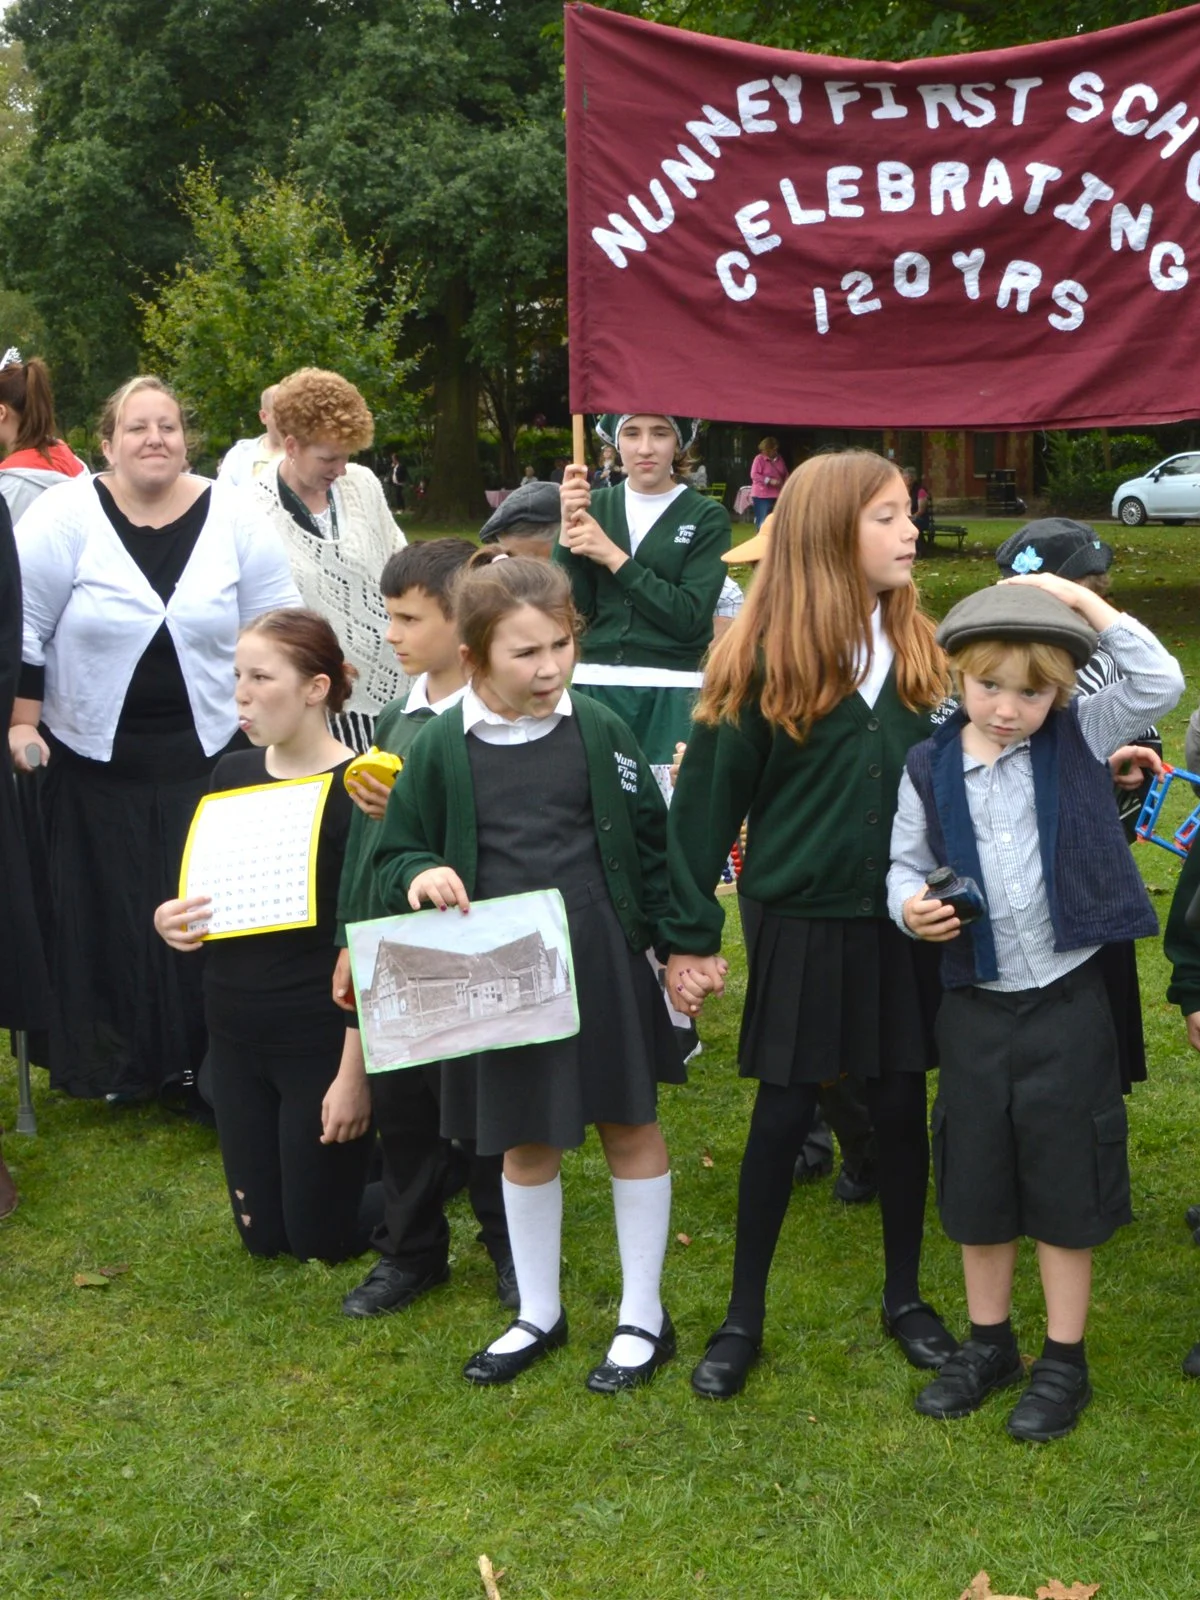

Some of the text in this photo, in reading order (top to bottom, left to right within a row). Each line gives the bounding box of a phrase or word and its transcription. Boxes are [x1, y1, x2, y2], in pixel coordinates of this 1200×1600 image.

[590, 74, 803, 268] NUNNEY
[825, 77, 1043, 129] FIRST
[715, 158, 1190, 301] CELEBRATING
[812, 248, 1089, 335] 120 YRS
[618, 765, 638, 782] Firs
